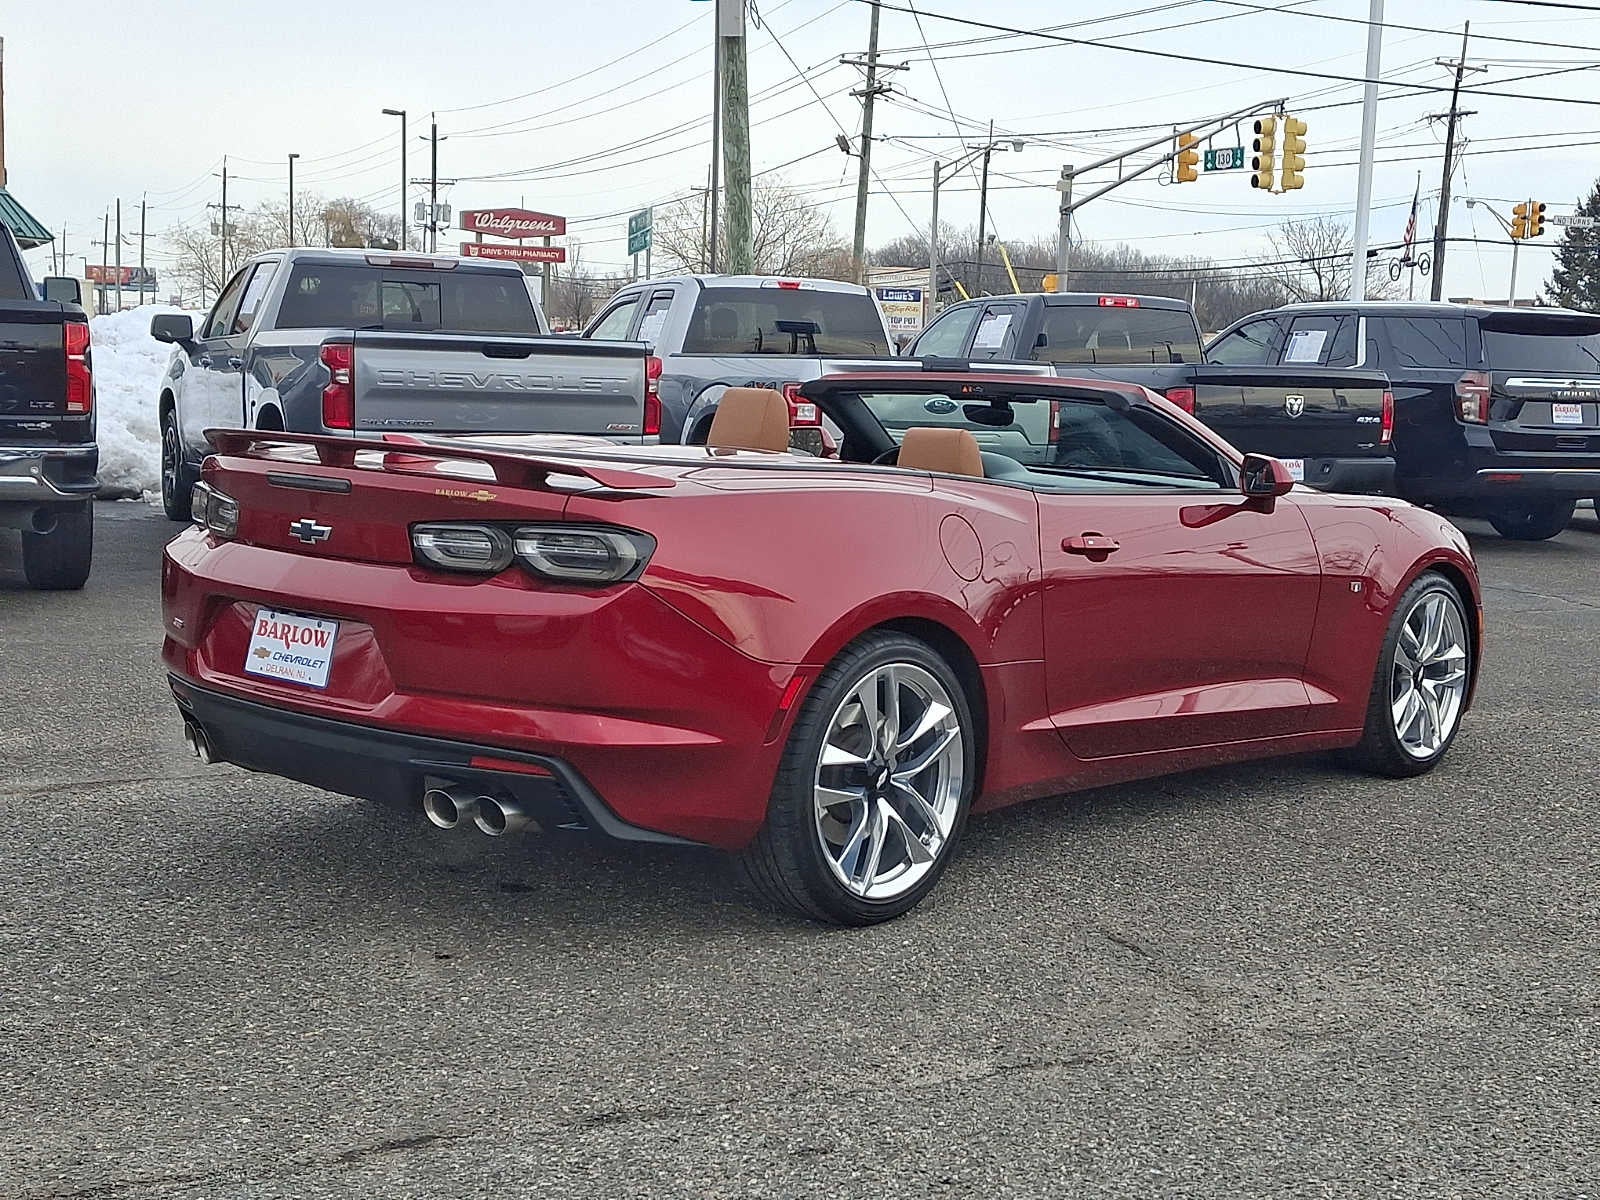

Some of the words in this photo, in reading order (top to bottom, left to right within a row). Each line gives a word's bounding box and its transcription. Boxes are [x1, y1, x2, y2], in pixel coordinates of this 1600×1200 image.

[1217, 153, 1231, 166] 130
[473, 212, 556, 234] Walgreens
[481, 247, 521, 256] DRIVE-THRU
[522, 250, 560, 259] PHARMACY
[882, 289, 915, 301] LOWE'S
[376, 369, 630, 393] CHEVROLET
[256, 619, 331, 650] BARLOW
[272, 651, 325, 669] CHEVROLET
[296, 669, 306, 679] NJ
